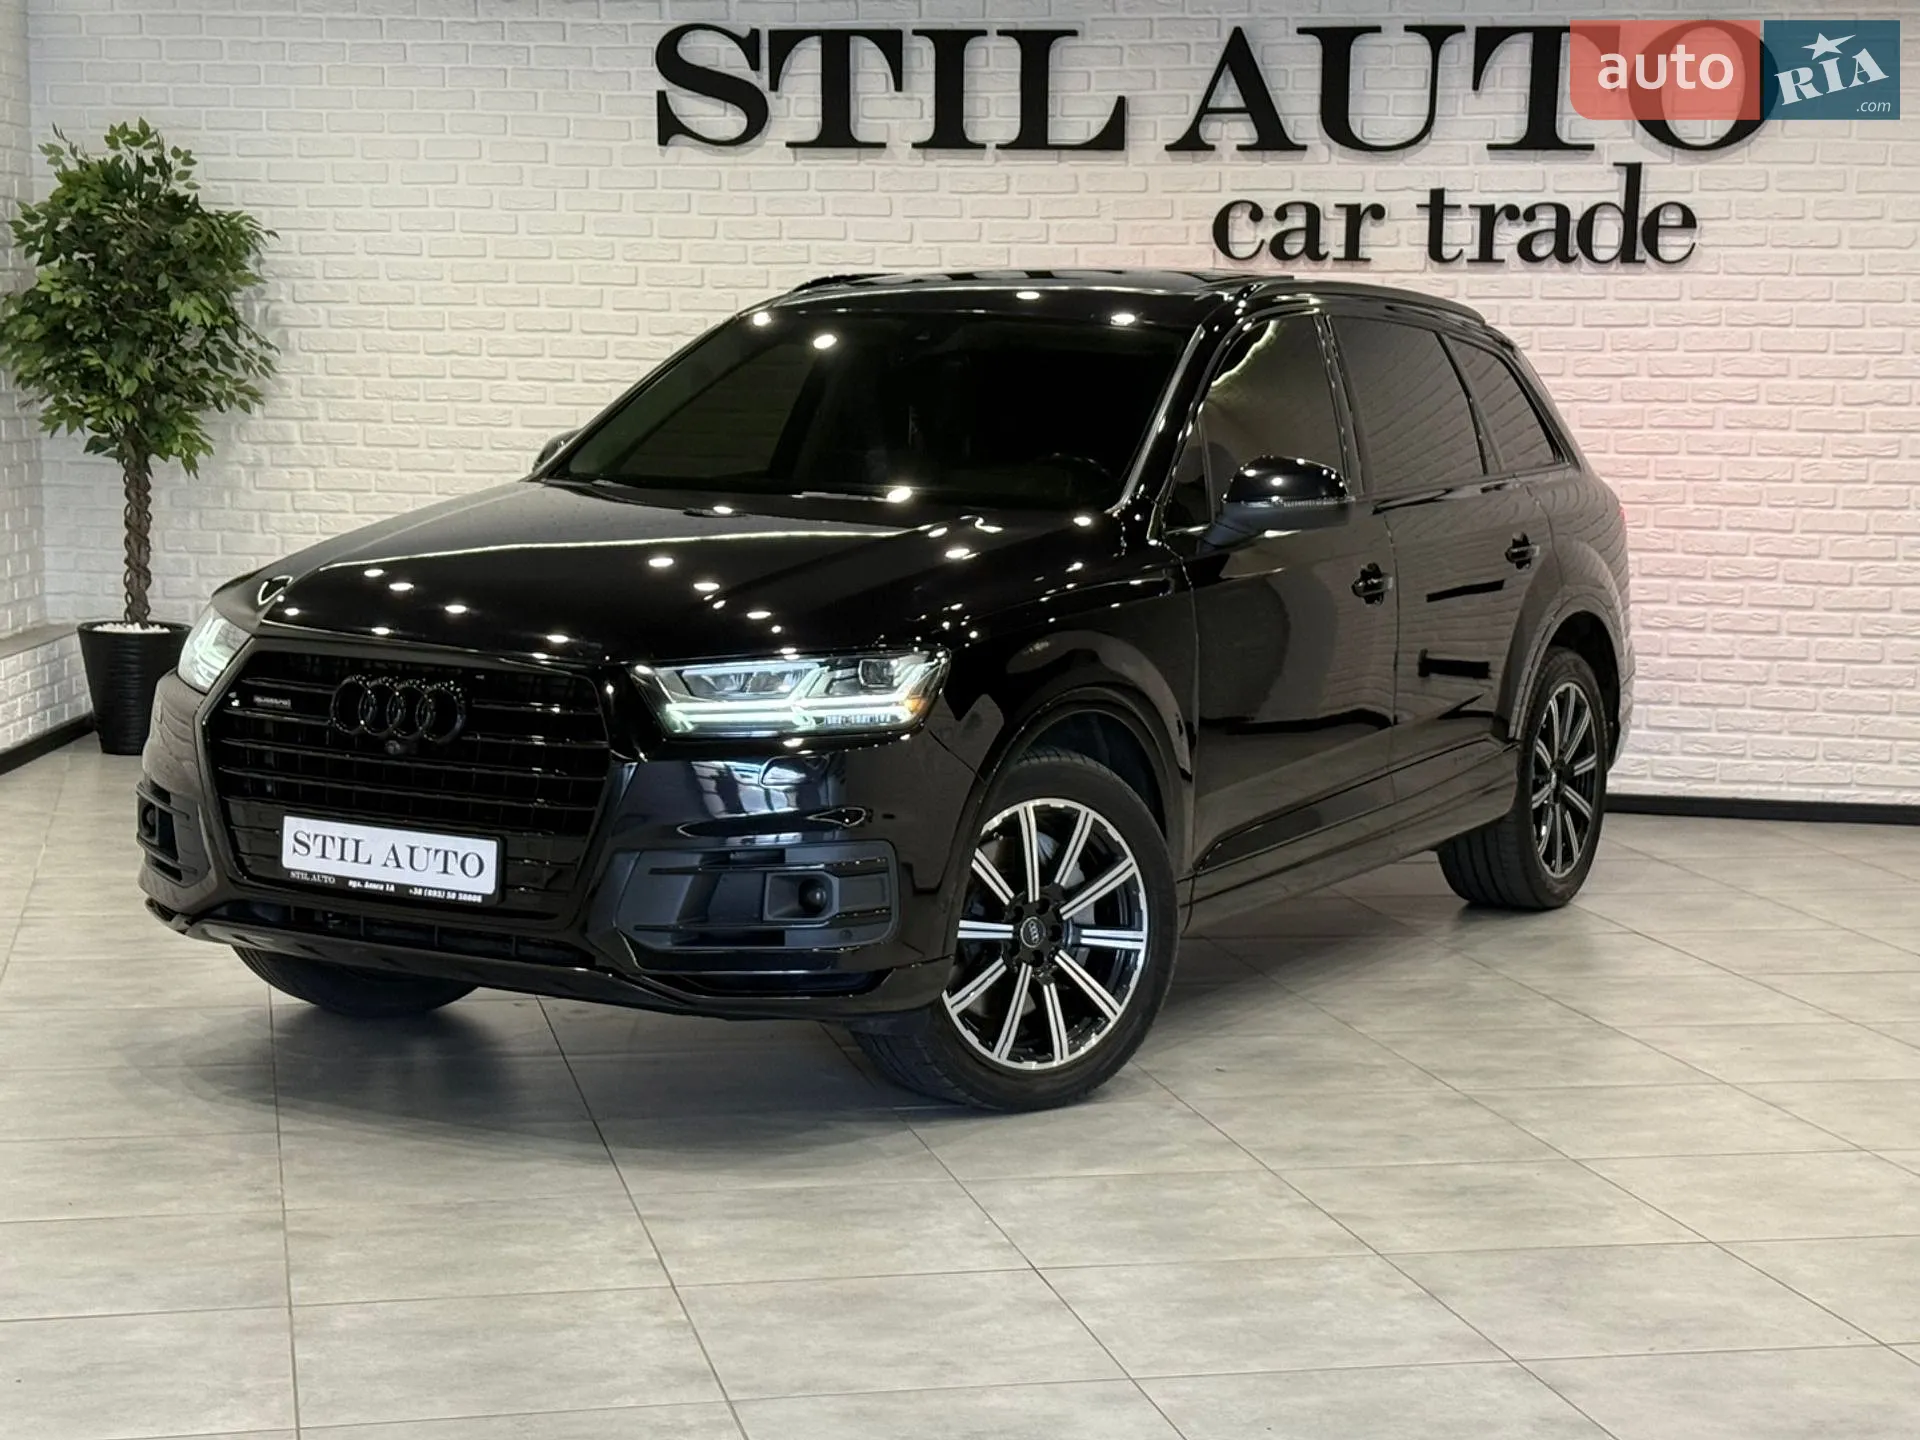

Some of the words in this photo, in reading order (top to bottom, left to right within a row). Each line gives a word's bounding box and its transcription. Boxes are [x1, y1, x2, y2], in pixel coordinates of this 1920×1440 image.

[655, 23, 1125, 151] STIL
[1164, 20, 1780, 152] AUTO
[1212, 198, 1386, 262] car
[1416, 161, 1698, 264] trade
[290, 871, 311, 881] STIL
[311, 873, 336, 884] AUTO
[292, 830, 372, 865] STIL
[382, 843, 485, 878] AUTO
